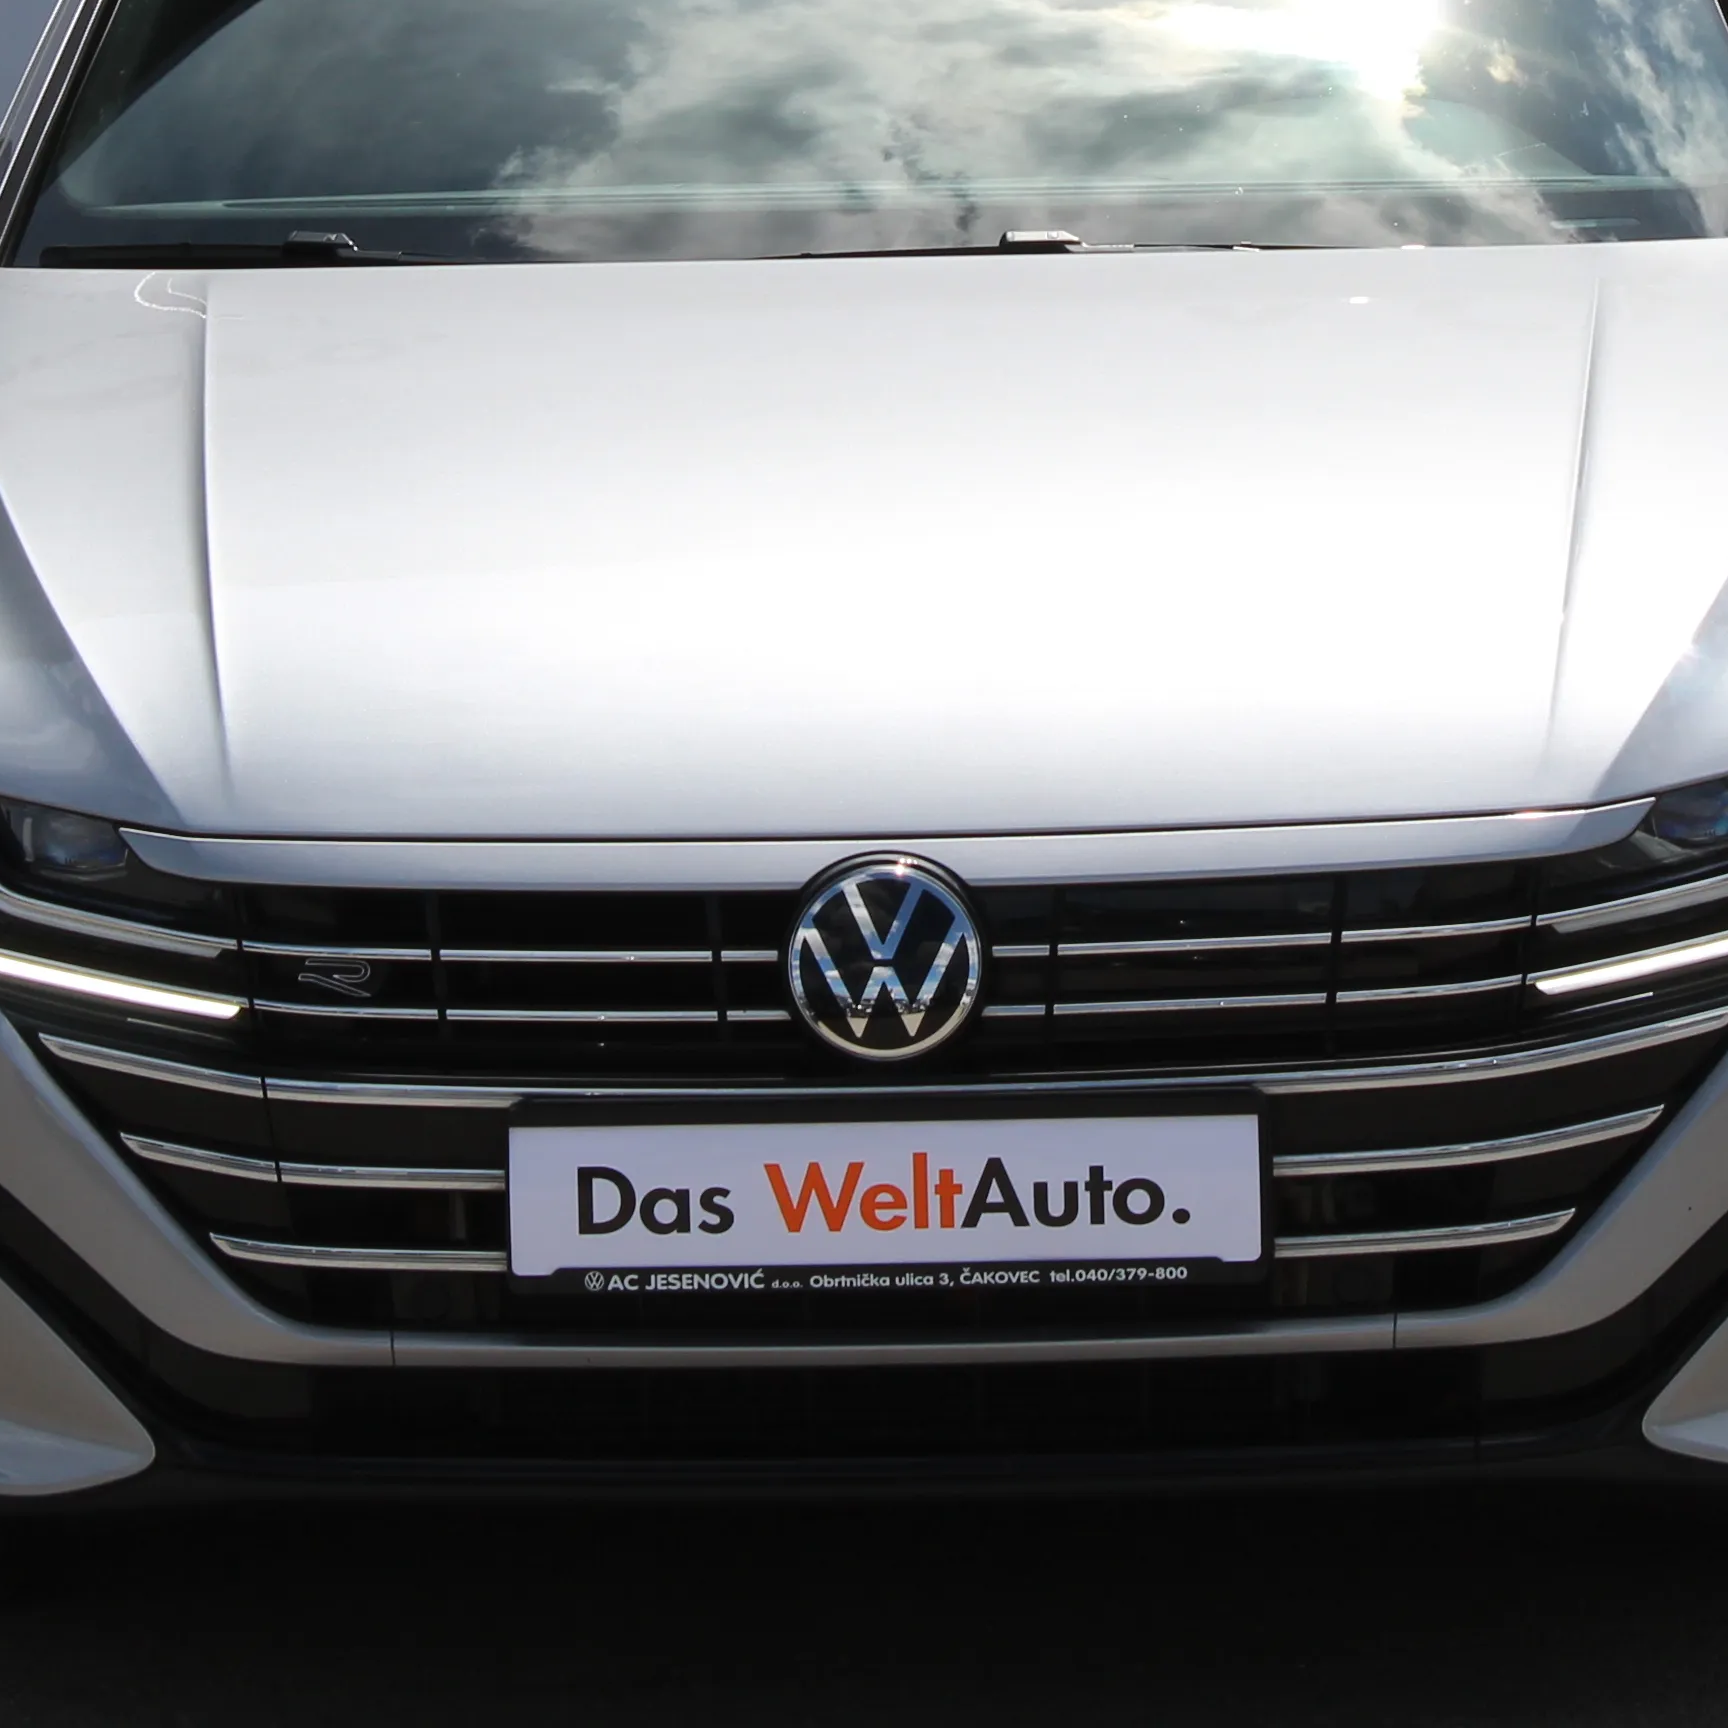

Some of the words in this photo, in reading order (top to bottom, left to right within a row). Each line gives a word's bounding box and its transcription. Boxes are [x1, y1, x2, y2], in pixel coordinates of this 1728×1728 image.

[577, 1166, 735, 1235] Das
[764, 1151, 1191, 1234] WeltAuto.
[607, 1275, 639, 1290] AC
[645, 1268, 765, 1290] JESENOVIĆ
[772, 1278, 803, 1288] d.o.o.
[809, 1273, 890, 1288] Obrtnička
[895, 1272, 934, 1286] ulica
[939, 1273, 954, 1287] 3,
[959, 1267, 1040, 1284] ČAKOVEC
[1050, 1266, 1188, 1283] tel.040/379-800
